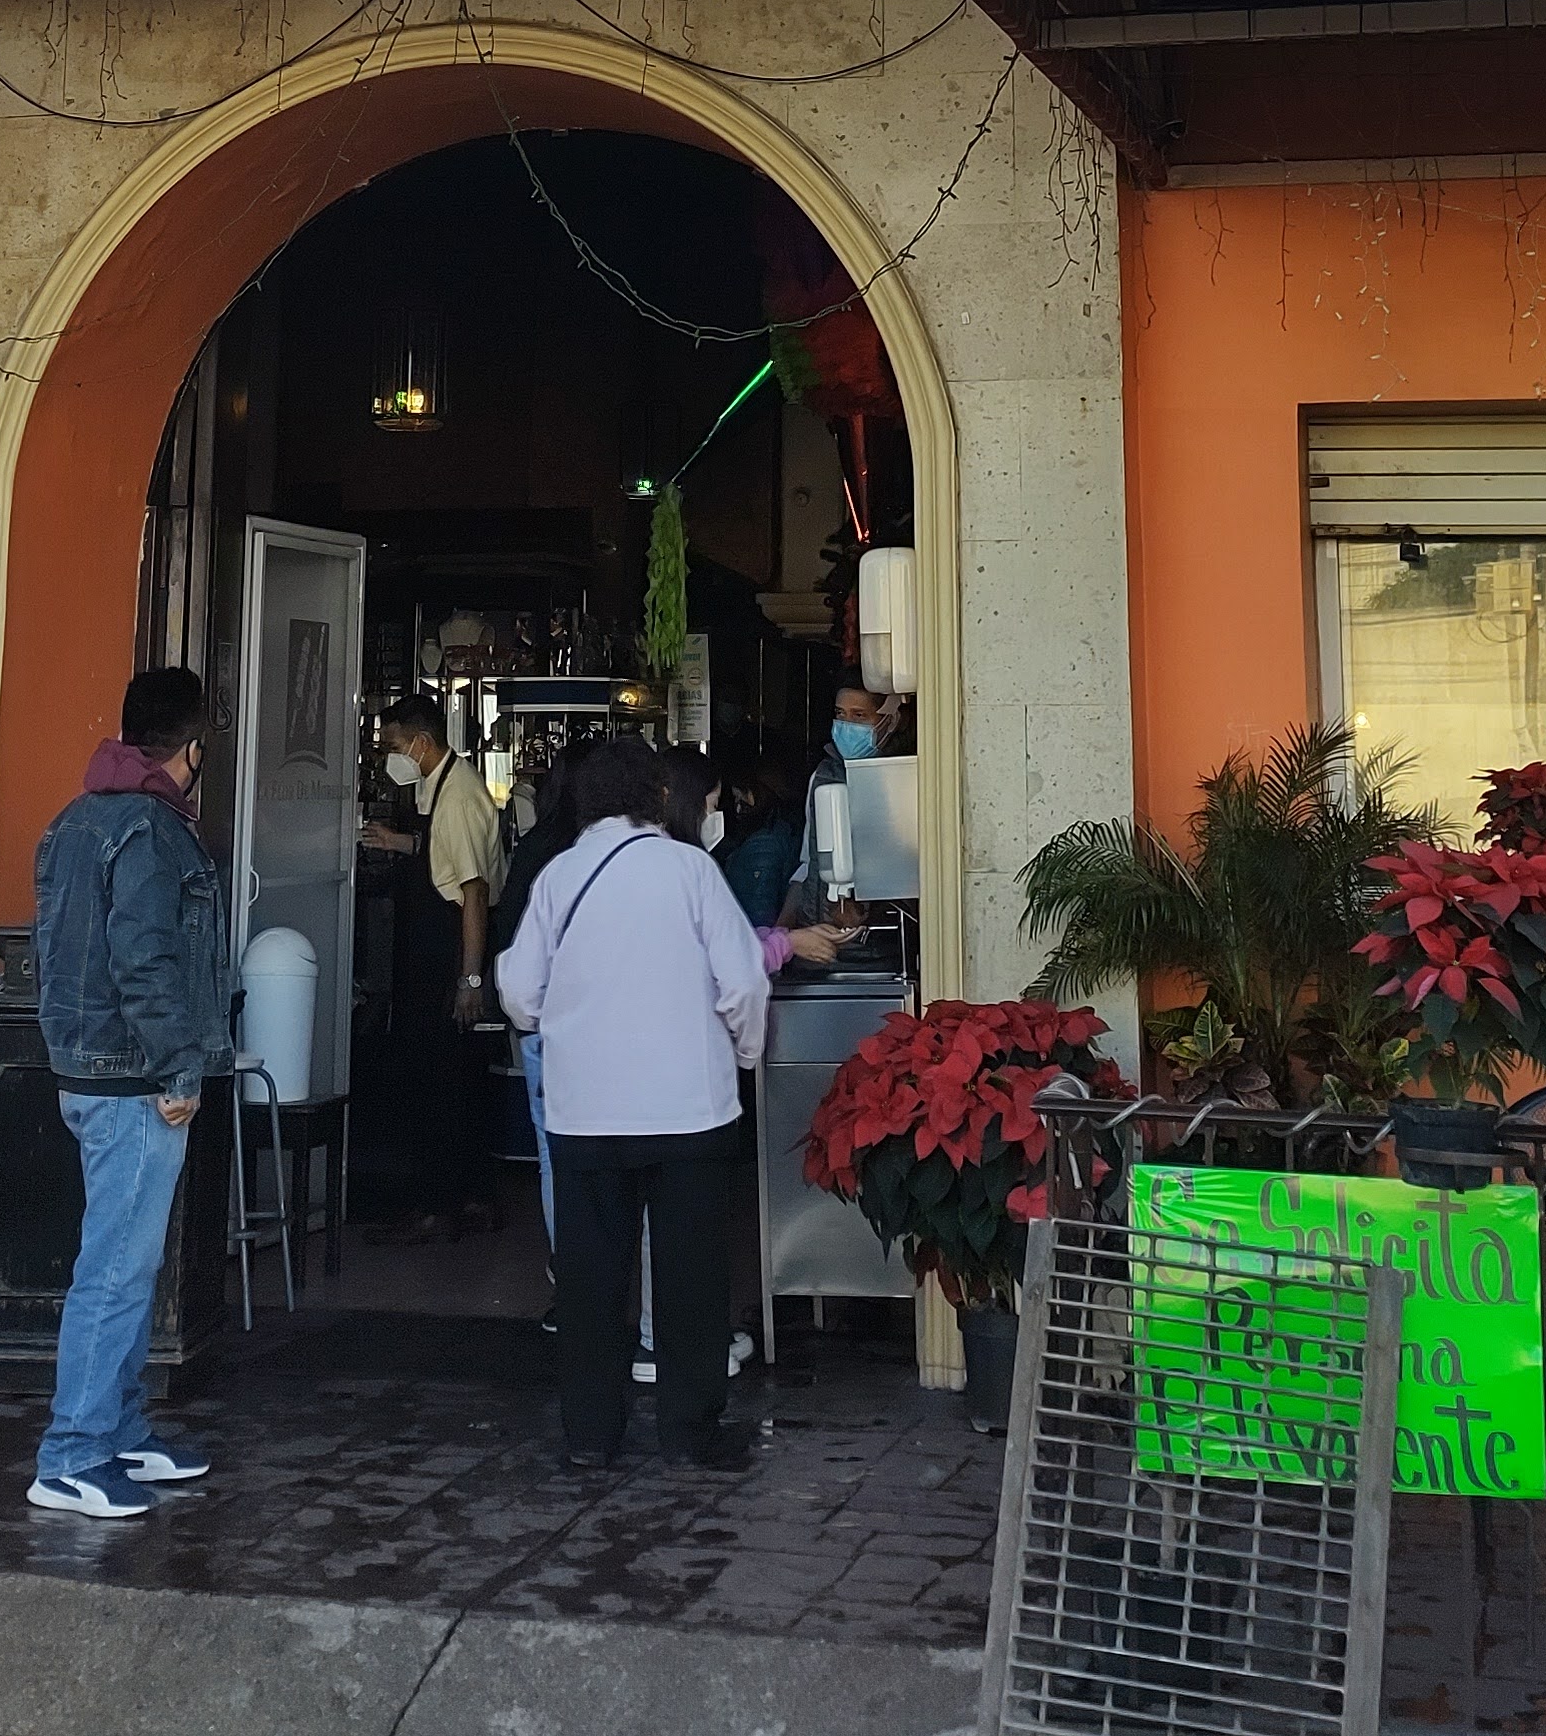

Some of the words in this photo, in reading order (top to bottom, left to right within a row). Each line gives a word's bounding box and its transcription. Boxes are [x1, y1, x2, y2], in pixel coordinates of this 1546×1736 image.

[1259, 1175, 1530, 1306] Solicita
[1204, 1285, 1478, 1388] Persna
[1153, 1366, 1523, 1496] Polivaente
